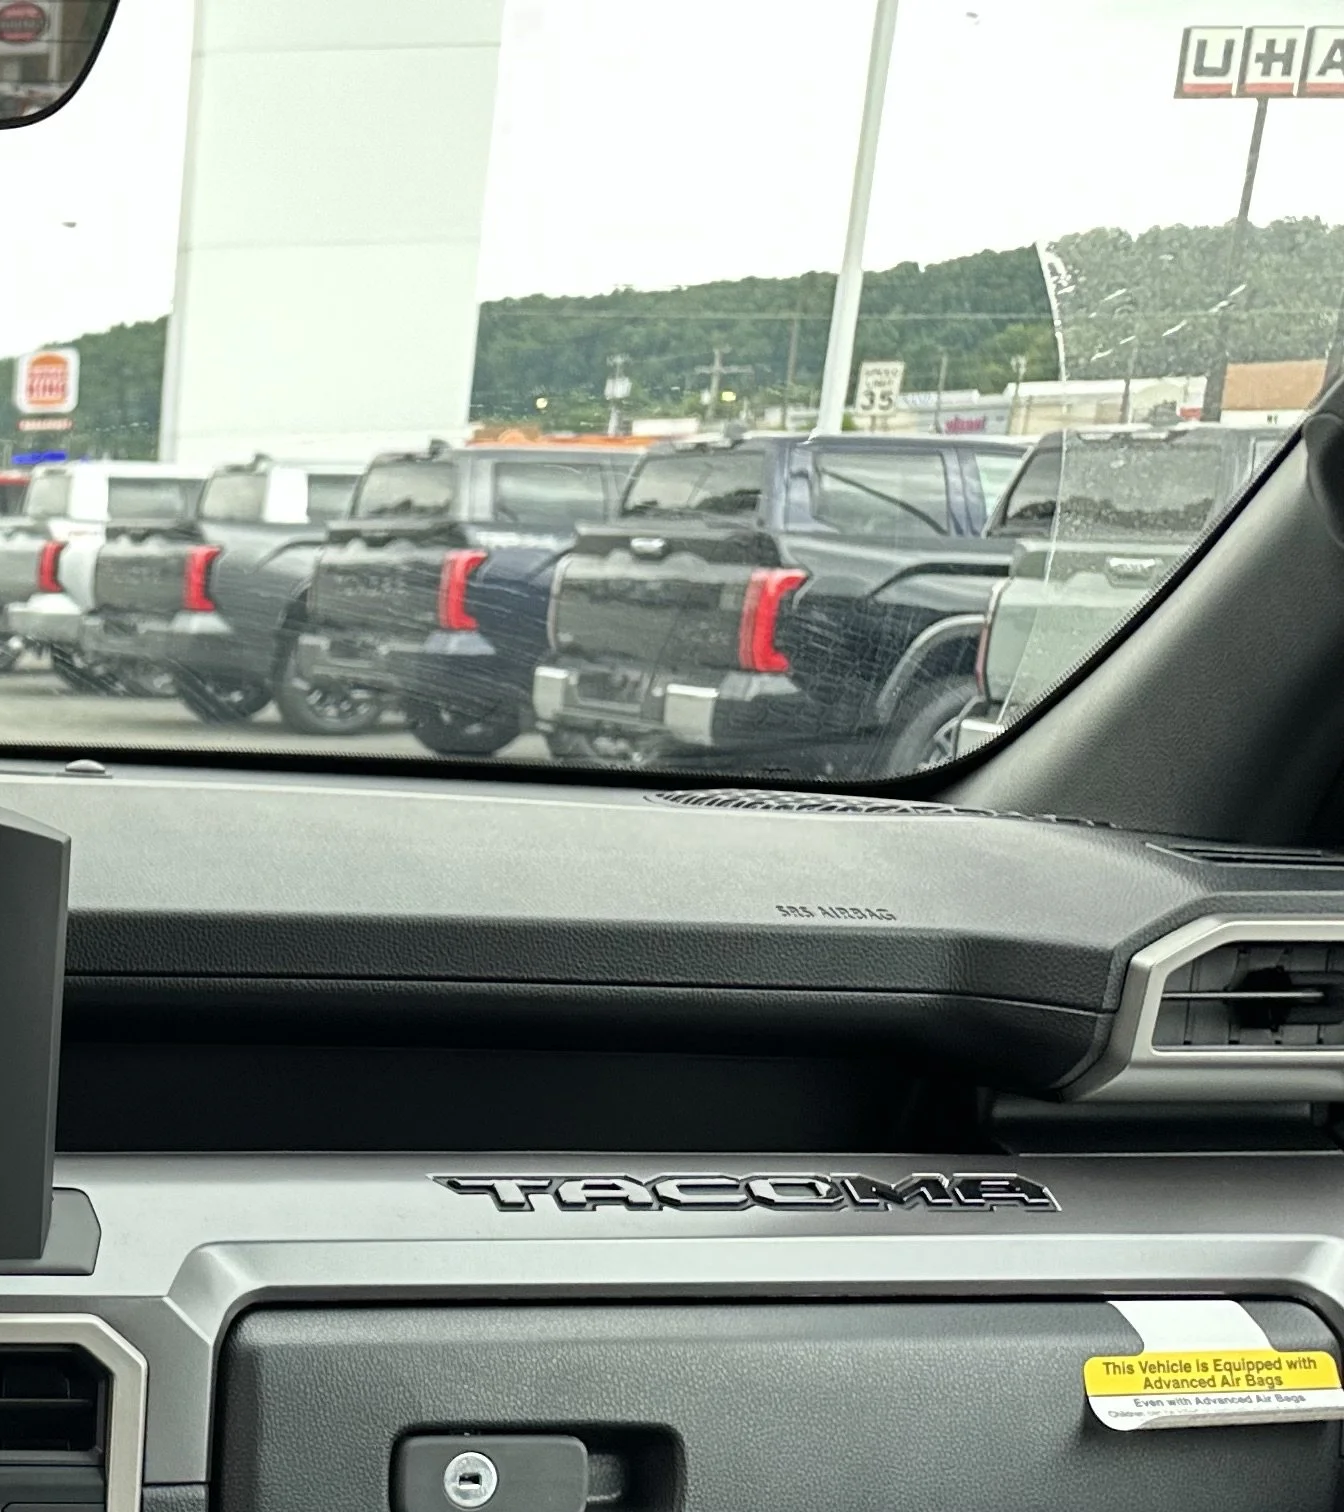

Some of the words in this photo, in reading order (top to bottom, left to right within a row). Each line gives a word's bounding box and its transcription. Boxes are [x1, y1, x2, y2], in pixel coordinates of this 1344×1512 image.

[861, 390, 894, 411] 35
[424, 1172, 1063, 1213] TACOMA
[1102, 1360, 1135, 1376] This
[1137, 1358, 1192, 1375] Vehicle
[1213, 1357, 1283, 1377] Equipped
[1285, 1357, 1318, 1371] with
[1142, 1376, 1218, 1391] Advanced
[1220, 1374, 1242, 1388] Air
[1245, 1374, 1284, 1392] Bags
[1133, 1397, 1165, 1409] Even
[1166, 1396, 1193, 1408] with
[1195, 1395, 1254, 1407] Advanced
[1255, 1393, 1272, 1404] Air
[1274, 1393, 1307, 1405] Bags
